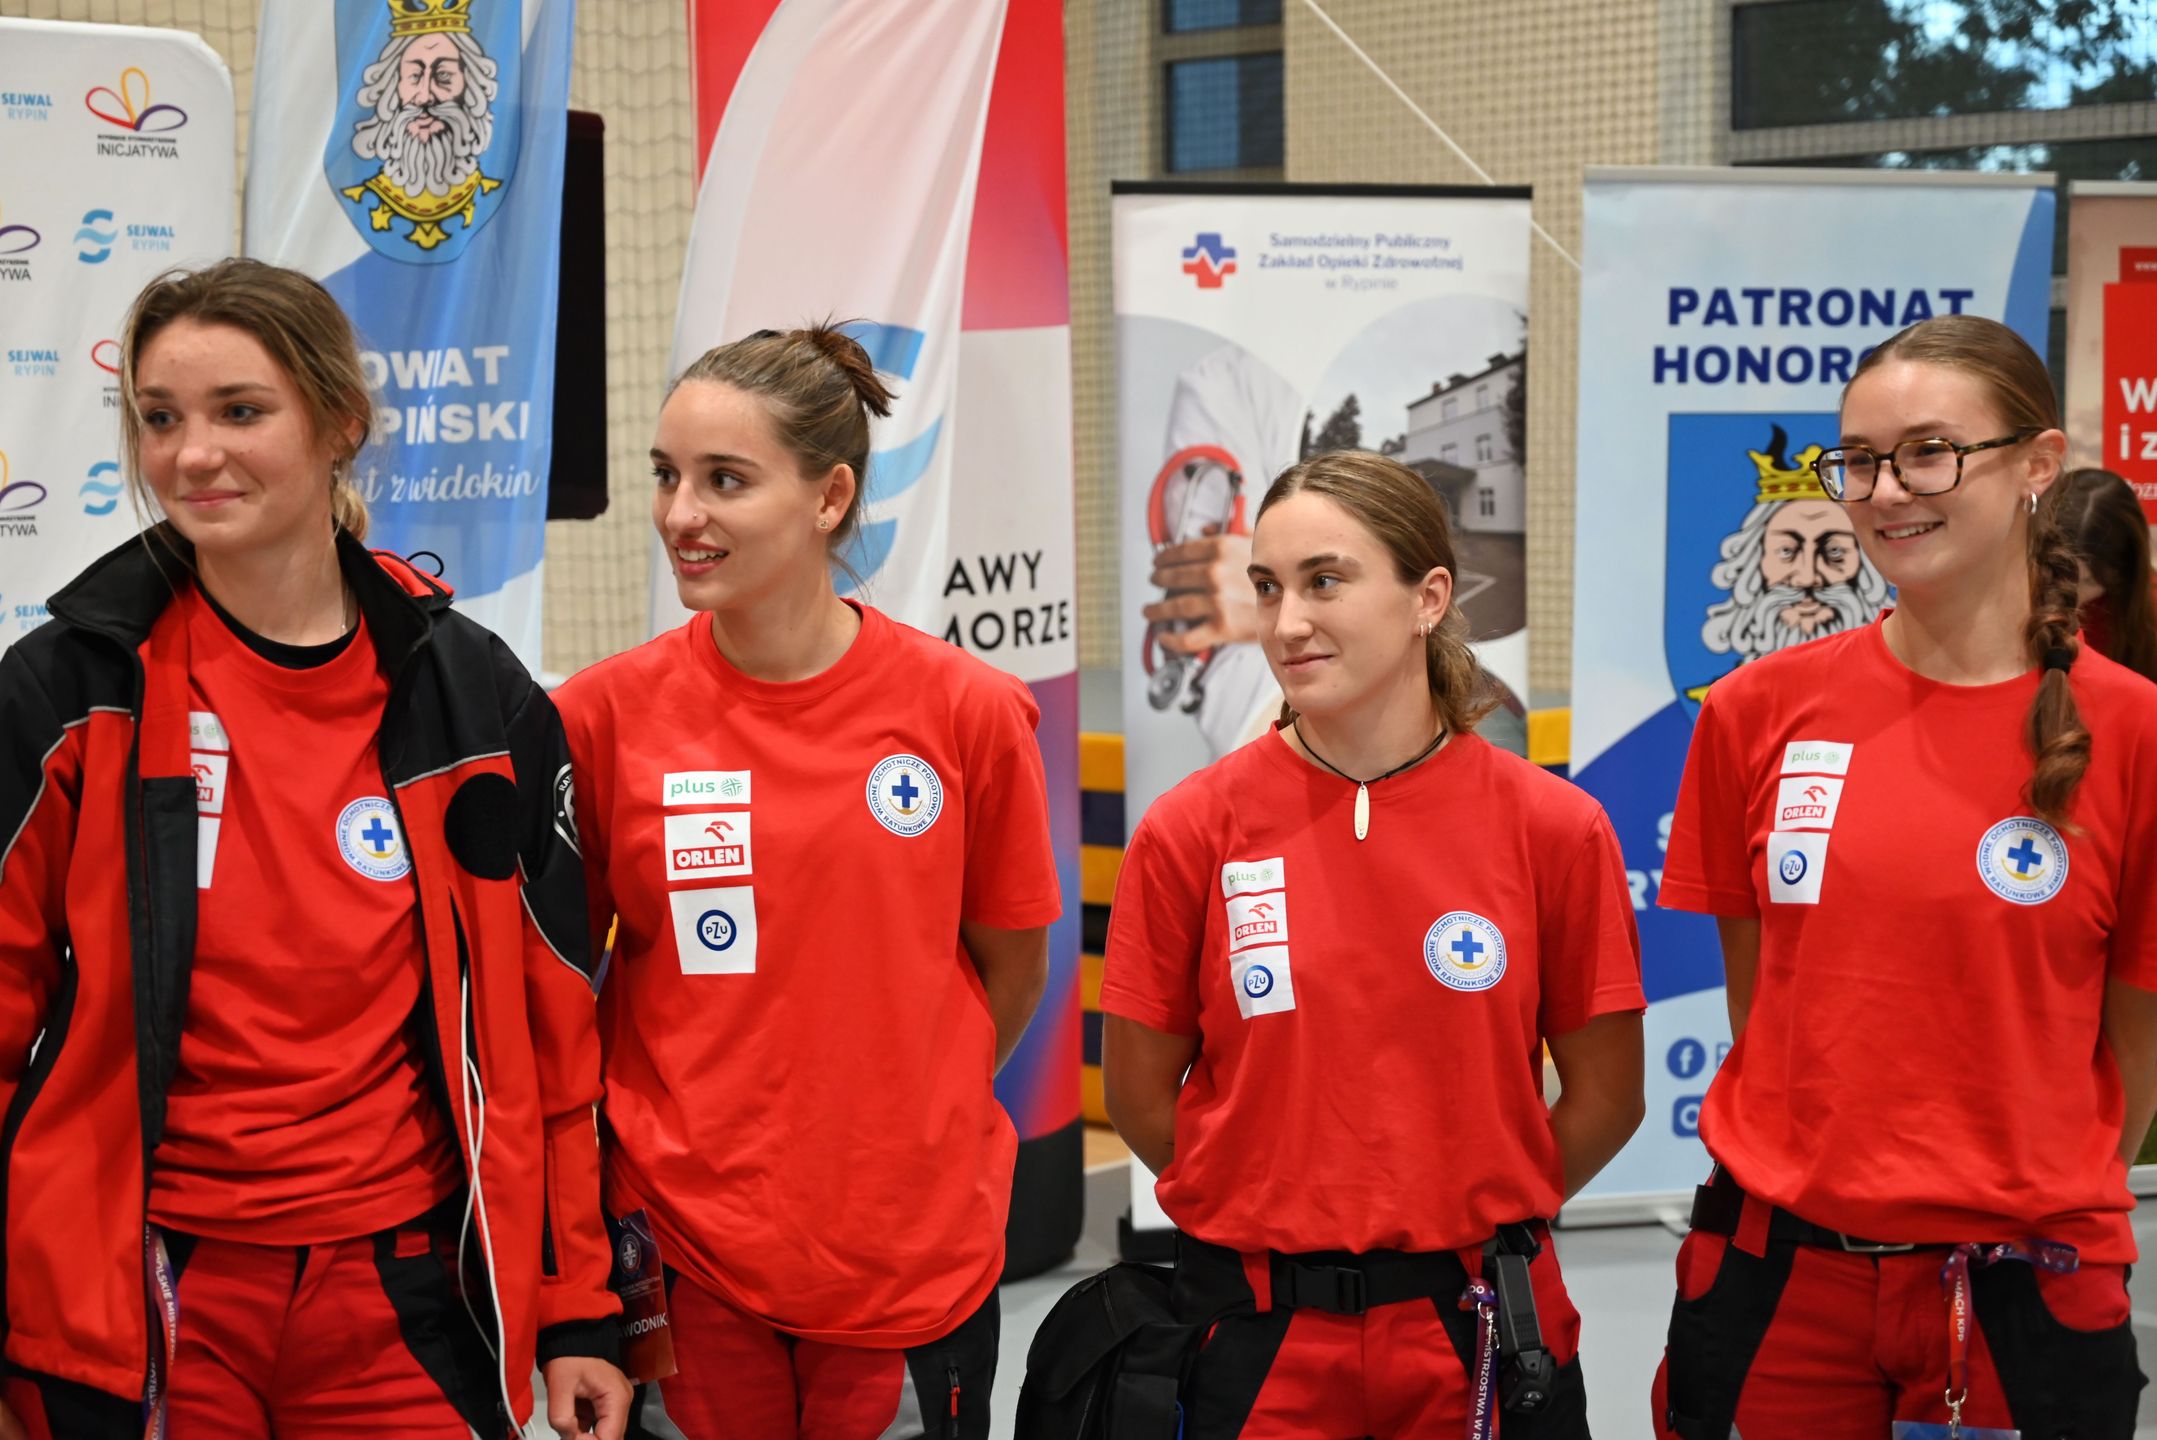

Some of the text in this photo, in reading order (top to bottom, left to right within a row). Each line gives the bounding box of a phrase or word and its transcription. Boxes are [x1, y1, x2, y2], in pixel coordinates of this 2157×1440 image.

[1, 92, 53, 107] SEJWAL
[7, 105, 48, 121] RYPIN
[97, 143, 179, 159] INICJATYWA
[126, 224, 175, 238] SEJWAL
[132, 239, 171, 251] RYPIN
[1269, 232, 1451, 249] Samodzielny Publiczny
[1372, 253, 1464, 270] Zdrowotnej
[1668, 287, 1975, 327] PATRONAT
[8, 350, 60, 362] SEJWAL
[14, 364, 56, 376] RYPIN
[1653, 346, 1880, 385] HONOR
[370, 395, 530, 445] PIŃSKI
[943, 550, 1042, 598] AWY
[1792, 750, 1821, 763] plus
[874, 759, 921, 782] OCHOTNICZE
[670, 779, 716, 798] plus
[1784, 807, 1823, 820] ORLEN
[676, 847, 741, 868] ORLEN
[1228, 872, 1257, 887] plus
[706, 921, 728, 939] PZU
[1236, 921, 1275, 939] ORLEN
[1248, 974, 1266, 989] PZU
[623, 1313, 668, 1338] WODNIK
